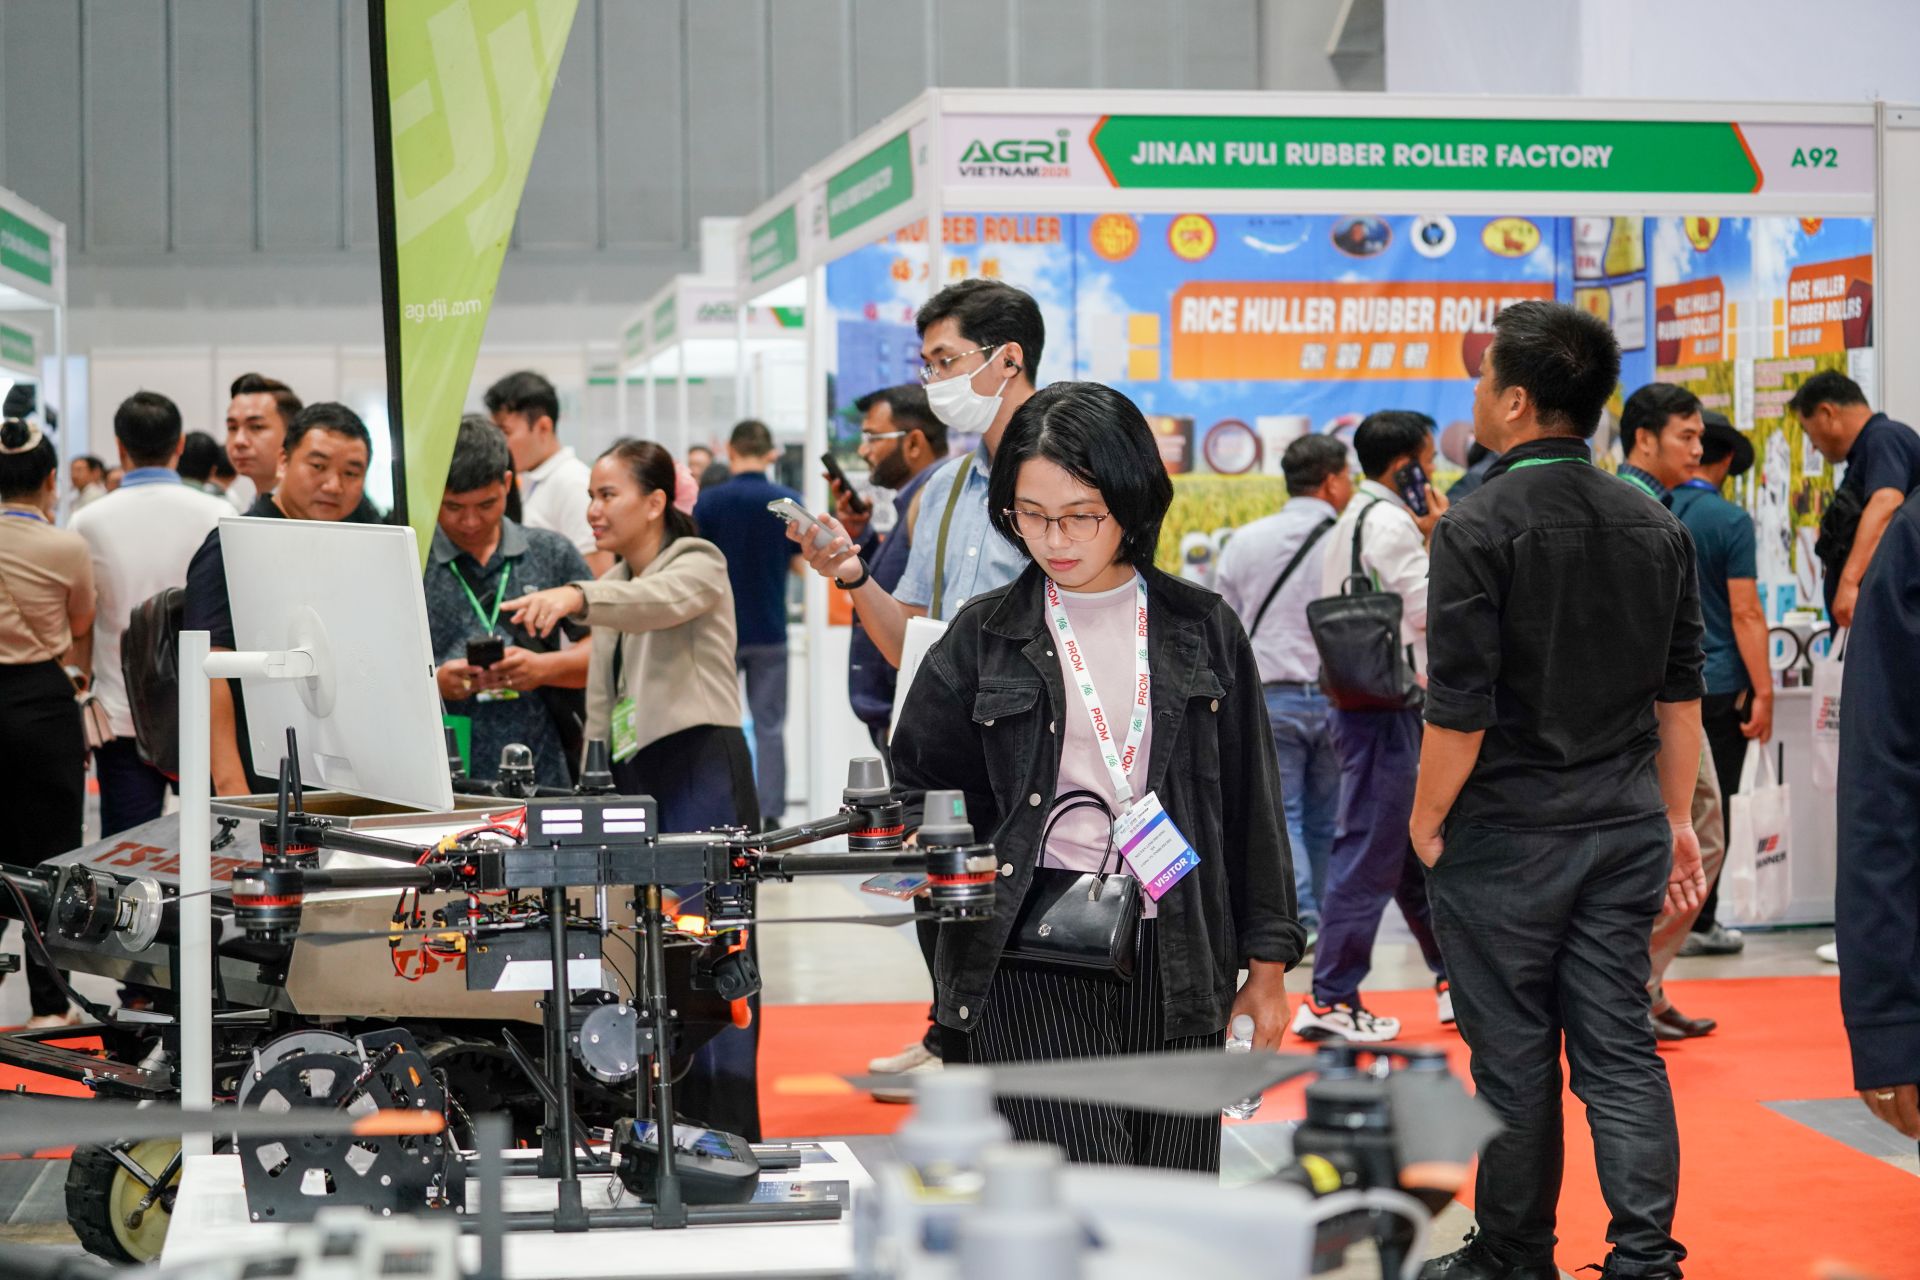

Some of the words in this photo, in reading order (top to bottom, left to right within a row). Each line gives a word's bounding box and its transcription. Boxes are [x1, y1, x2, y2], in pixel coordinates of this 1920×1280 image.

[960, 128, 1071, 163] AGRI
[1131, 141, 1216, 165] JINAN
[1224, 142, 1277, 165] FULI
[1285, 142, 1386, 166] RUBBER
[1393, 143, 1488, 167] ROLLER
[1495, 144, 1613, 168] FACTORY
[1791, 147, 1838, 167] A92
[896, 216, 978, 242] RUBER
[983, 216, 1061, 242] ROLLER
[1180, 296, 1238, 333] RICE
[1242, 297, 1335, 334] HULLER
[1341, 297, 1435, 334] RUBBER
[1440, 297, 1542, 334] ROLL
[1138, 607, 1148, 637] PROM
[1065, 640, 1084, 672] PROM
[1137, 673, 1148, 706] PROM
[1091, 707, 1110, 741] PROM
[1121, 745, 1137, 771] ROM
[1154, 857, 1188, 888] VISITOR
